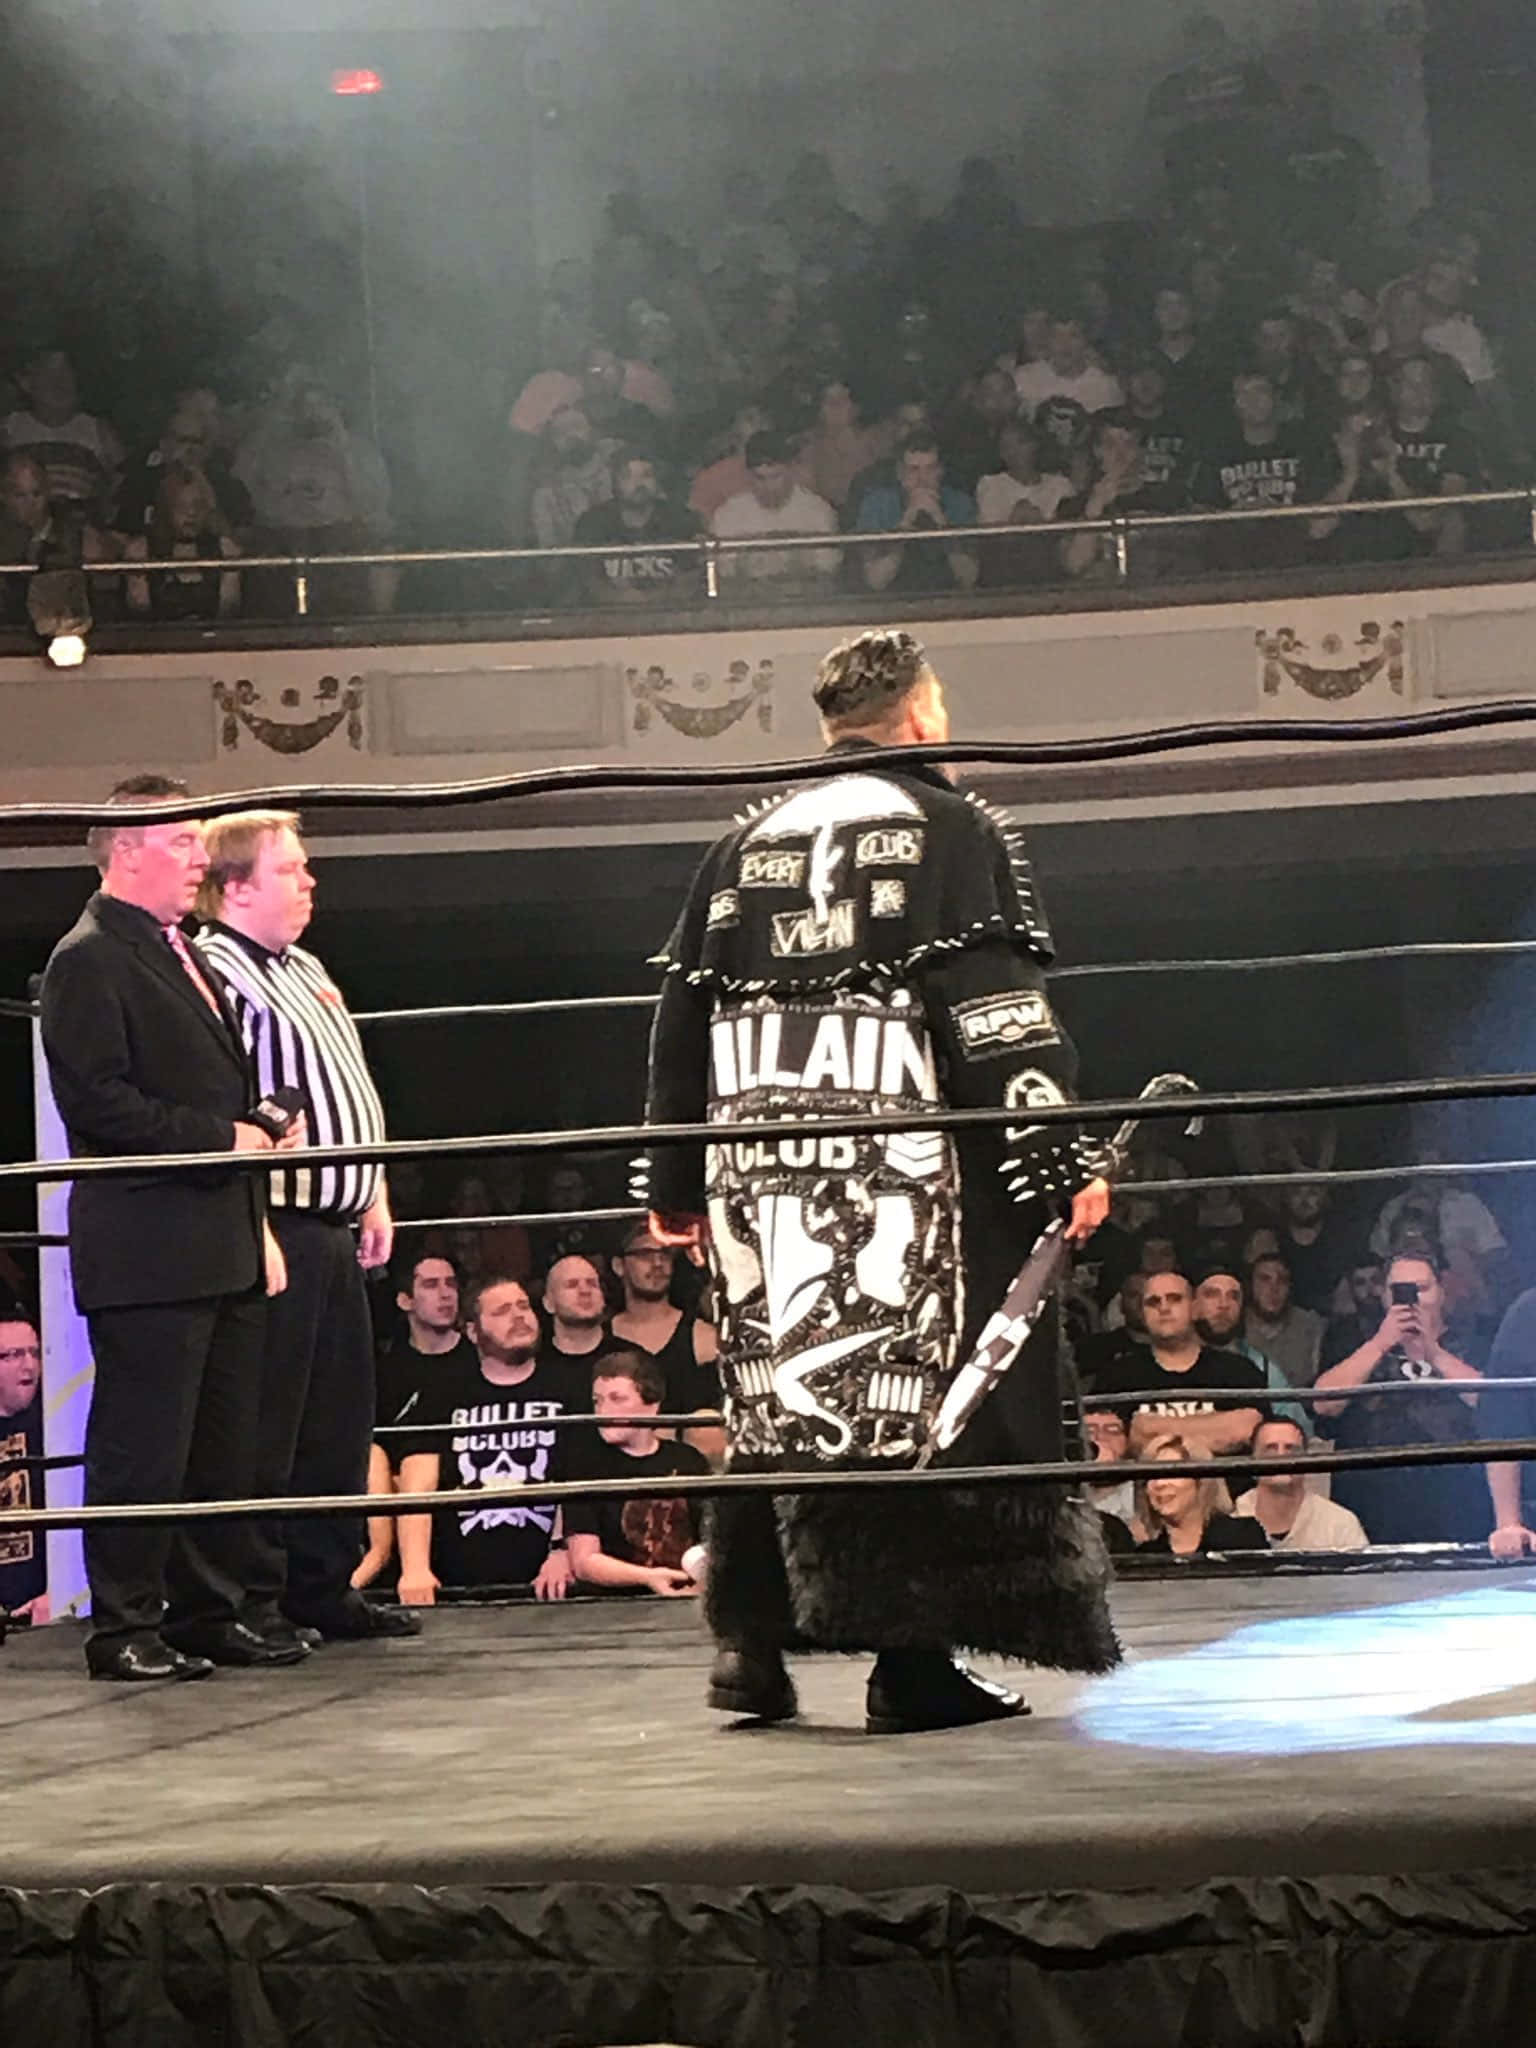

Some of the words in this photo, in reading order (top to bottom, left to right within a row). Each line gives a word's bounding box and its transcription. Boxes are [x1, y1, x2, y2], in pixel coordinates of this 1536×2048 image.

[856, 829, 920, 861] CLUB
[965, 1002, 1044, 1039] RPW
[712, 1013, 938, 1101] ILLAIN
[452, 1402, 563, 1425] BULLET
